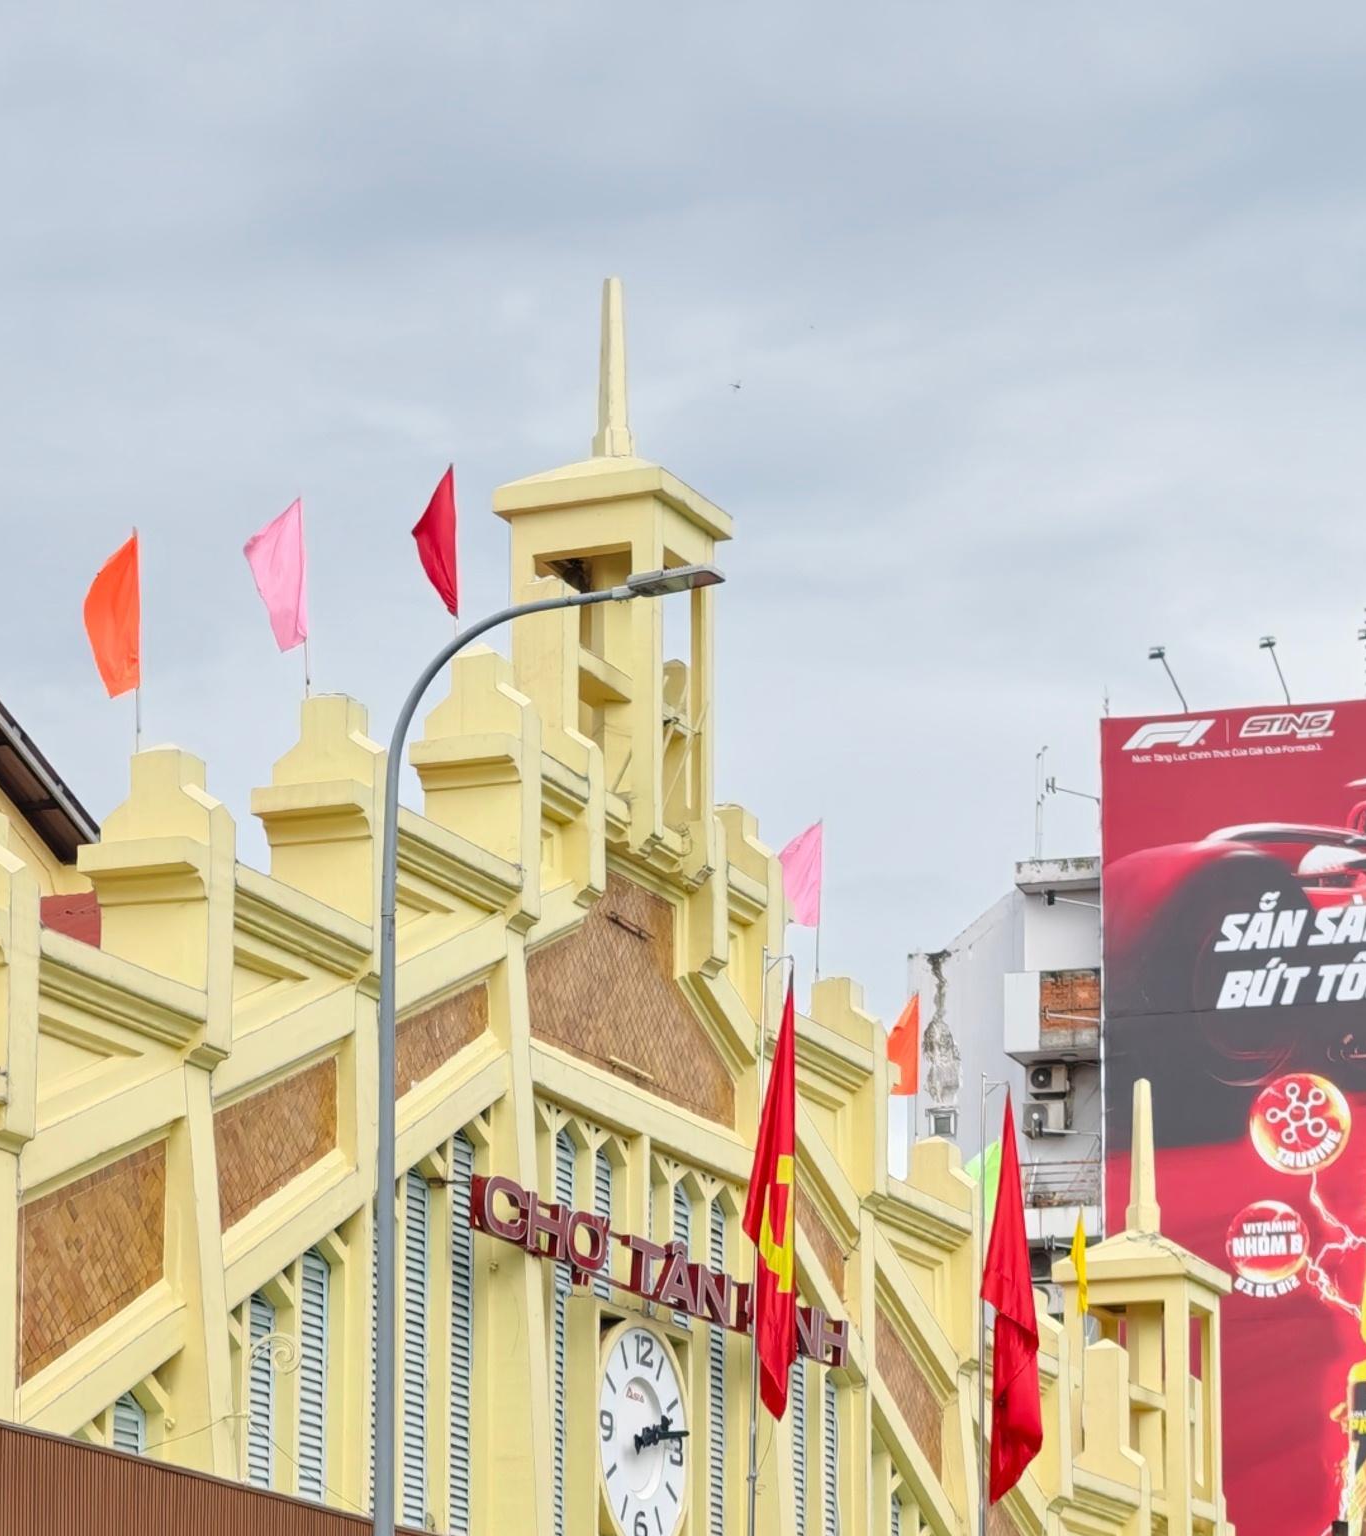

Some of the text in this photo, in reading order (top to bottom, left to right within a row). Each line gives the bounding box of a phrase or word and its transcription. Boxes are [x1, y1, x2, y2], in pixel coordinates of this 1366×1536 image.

[1275, 1127, 1342, 1168] TAURINE
[1242, 1220, 1297, 1235] VITAMIN
[1290, 1234, 1304, 1254] B
[620, 1233, 732, 1327] TÂN
[634, 1334, 654, 1369] 12
[600, 1411, 614, 1442] 9
[669, 1436, 684, 1467] 3
